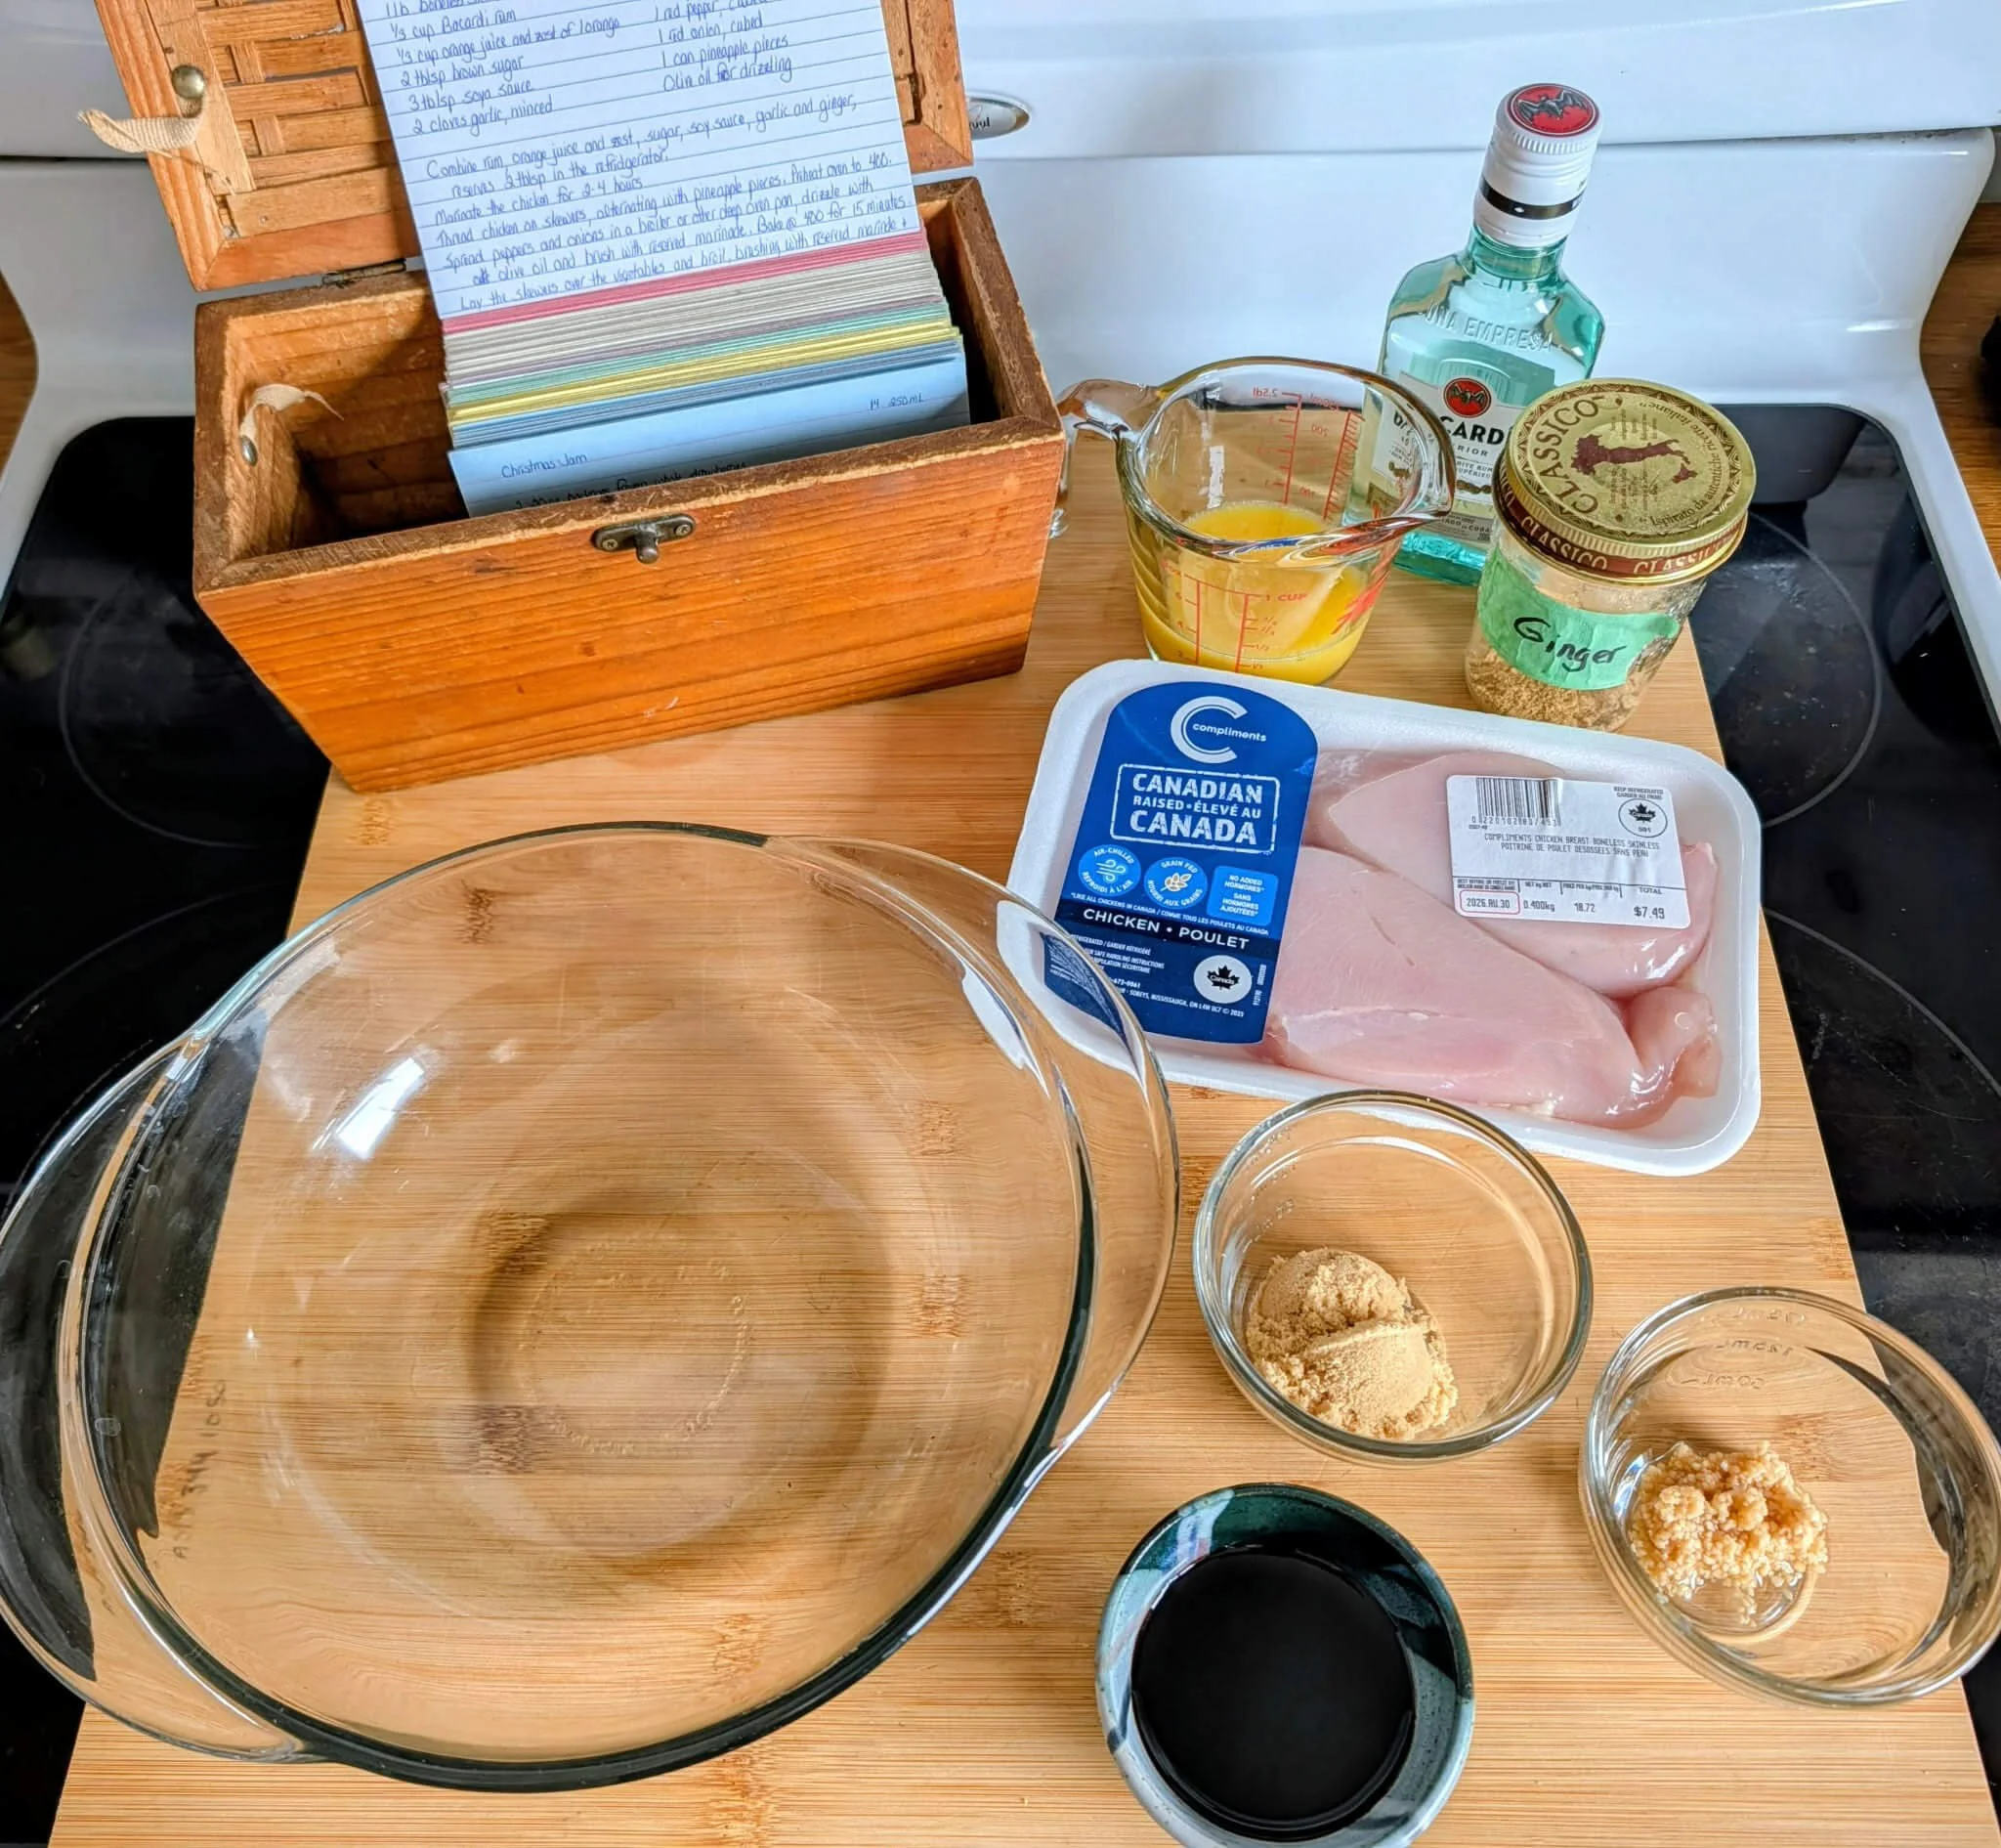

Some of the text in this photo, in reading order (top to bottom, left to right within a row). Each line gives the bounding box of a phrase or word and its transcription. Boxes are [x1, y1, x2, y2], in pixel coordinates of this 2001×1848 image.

[412, 24, 436, 41] cup
[442, 10, 490, 34] Bacardi
[731, 10, 763, 33] cubed
[417, 47, 440, 66] cup
[442, 42, 477, 64] orange
[473, 32, 506, 60] juice
[512, 27, 532, 46] and
[560, 21, 576, 39] of
[673, 51, 696, 66] can
[700, 39, 749, 71] pineapple
[753, 34, 789, 63] pieces
[401, 70, 410, 87] 2
[451, 62, 486, 81] brown
[490, 55, 524, 82] sugar
[698, 65, 712, 87] oil
[740, 54, 792, 84] drizzling
[408, 94, 420, 111] 3
[498, 79, 533, 97] sauce
[412, 118, 423, 136] 2
[430, 114, 467, 133] cloves
[511, 94, 553, 120] minced
[426, 156, 478, 179] Combine
[512, 148, 547, 169] orange
[546, 142, 578, 166] juice
[584, 136, 605, 154] and
[688, 120, 710, 139] soy
[755, 101, 789, 133] garlic
[793, 97, 813, 116] and
[436, 203, 484, 226] Marinate
[487, 198, 504, 216] the
[512, 190, 549, 212] chicken
[558, 185, 575, 203] for
[614, 175, 644, 194] hours
[482, 221, 519, 241] chicken
[524, 220, 537, 234] on
[596, 197, 658, 219] alternating
[662, 187, 690, 208] with
[694, 180, 743, 212] pineapple
[827, 162, 849, 178] oven
[851, 155, 862, 172] to
[444, 248, 484, 275] Spread
[492, 241, 535, 268] peppers
[540, 235, 562, 251] and
[567, 228, 605, 248] onions
[610, 223, 621, 240] in
[677, 216, 688, 228] or
[692, 204, 715, 225] other
[745, 198, 771, 216] oven
[802, 185, 840, 205] drizzle
[848, 176, 873, 197] with
[498, 265, 525, 282] olive
[532, 256, 548, 276] oil
[554, 251, 576, 270] and
[584, 245, 615, 267] brush
[622, 239, 643, 259] with
[804, 209, 825, 224] 400
[828, 200, 847, 219] for
[853, 197, 864, 216] 15
[1425, 304, 1554, 353] UNA EMPRESA
[501, 452, 588, 479] Christmas Jam
[1695, 498, 1709, 511] da
[1520, 516, 1608, 572] CLASSICO
[1277, 592, 1308, 603] CUP
[1513, 617, 1628, 673] Ginger
[1192, 723, 1267, 743] compliments
[1132, 773, 1263, 804] CANADIAN
[1132, 795, 1262, 820] RAISED ÉLEVÉ AU
[1129, 809, 1257, 846] CANADA
[1484, 832, 1532, 843] COMPLIMENTS
[1534, 834, 1563, 844] CHICKEN
[1565, 835, 1590, 846] BREAST
[1593, 836, 1626, 848] BONELESS
[1501, 841, 1533, 852] POITRINE
[1536, 842, 1545, 852] DE
[1547, 843, 1572, 853] POULET
[1160, 859, 1199, 875] GRAIN FED
[1228, 874, 1263, 886] NO ADDED
[1232, 891, 1253, 902] SANS
[1638, 886, 1664, 896] TOTAL
[1523, 900, 1555, 913] 0.400kg
[1573, 902, 1597, 914] 18.72
[1633, 905, 1666, 921] $7.49
[1083, 908, 1162, 934] CHICKEN
[1178, 925, 1251, 951] POULET
